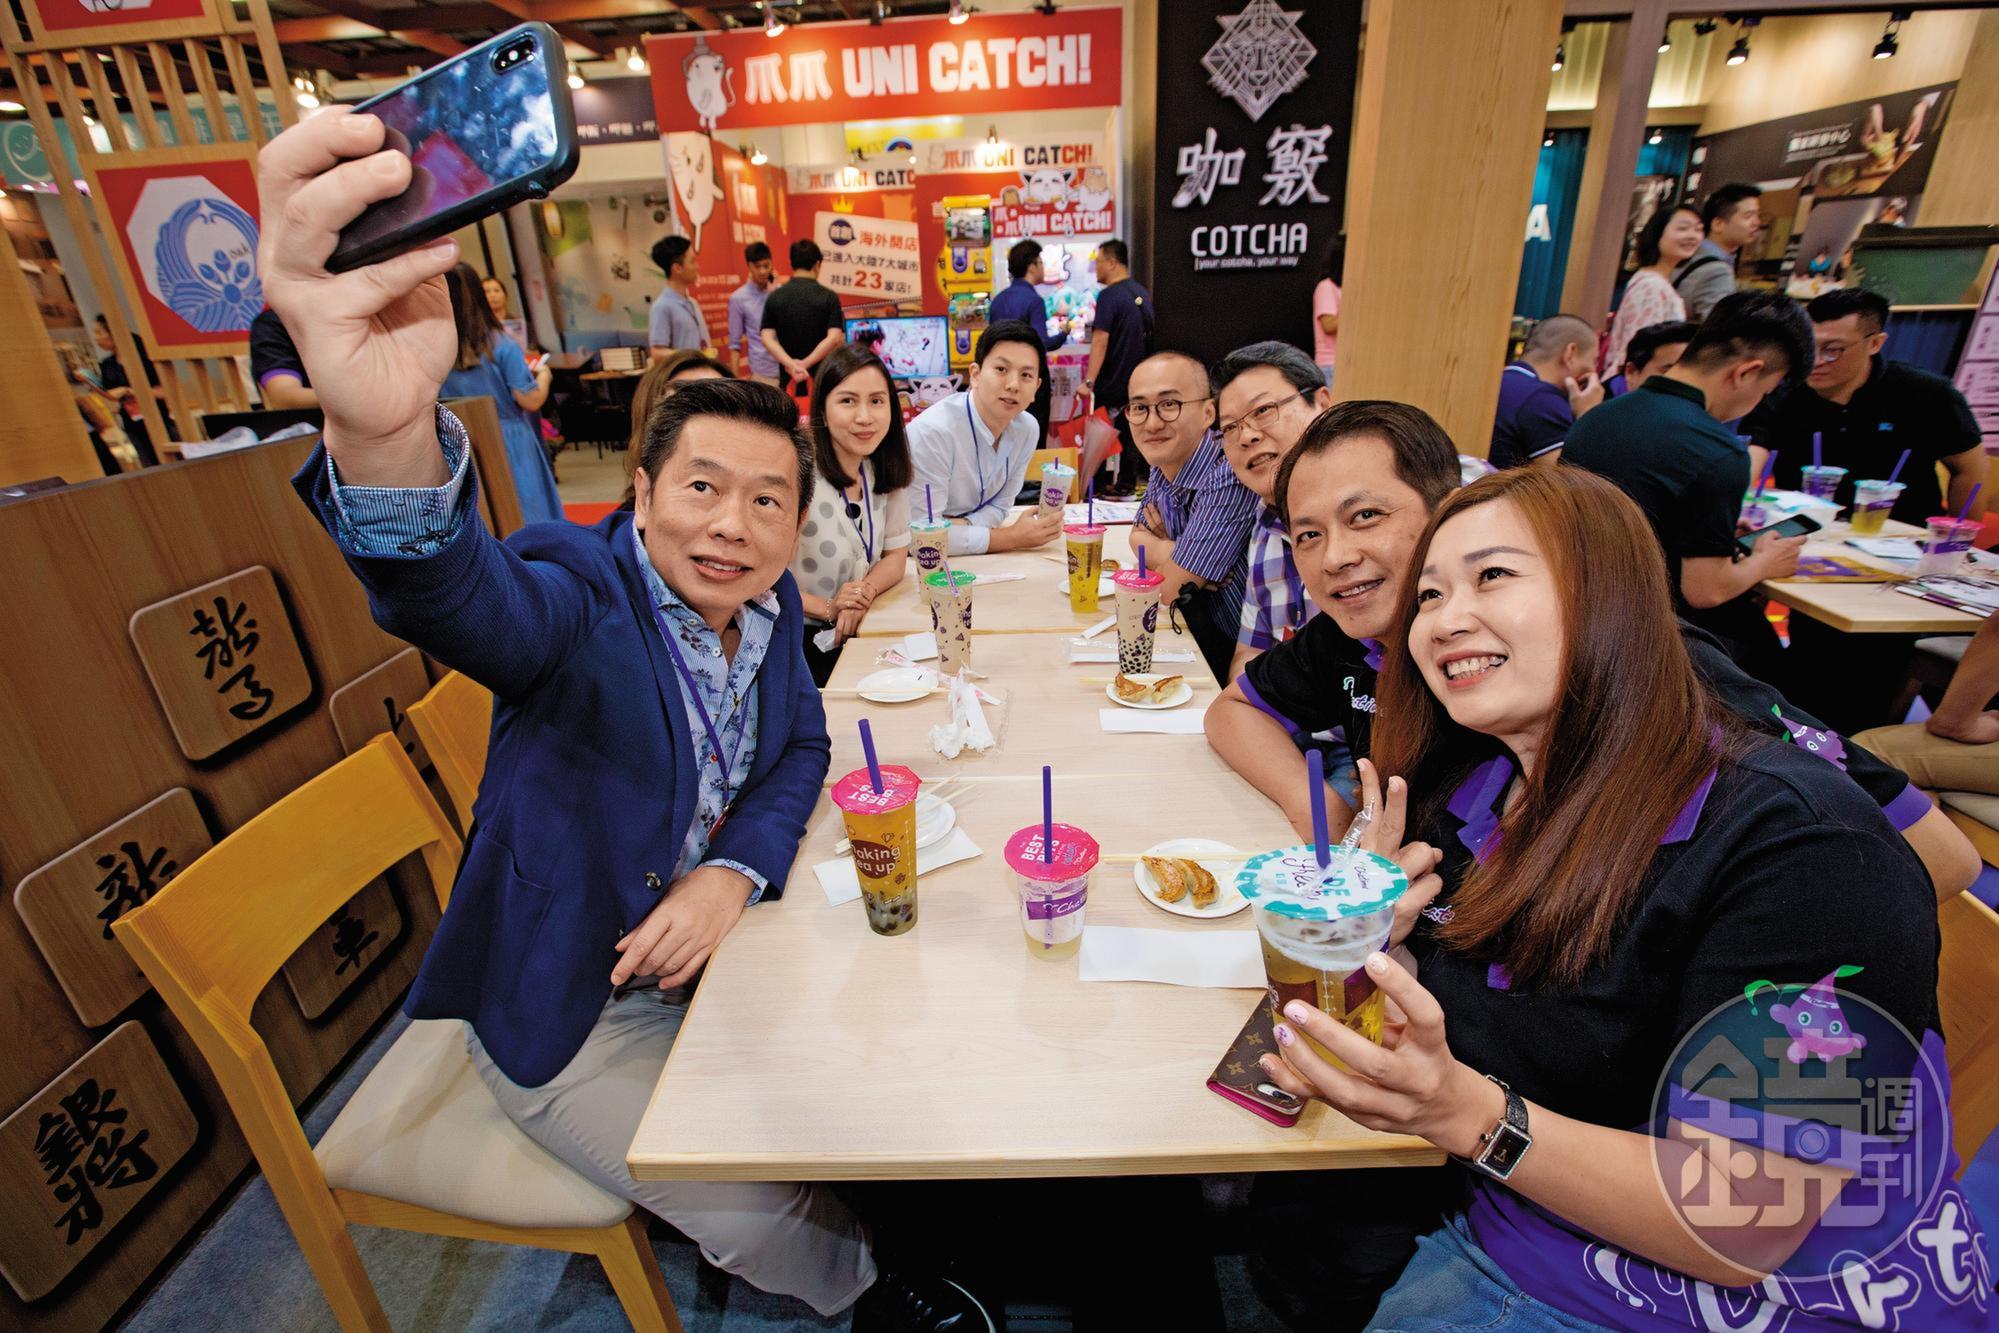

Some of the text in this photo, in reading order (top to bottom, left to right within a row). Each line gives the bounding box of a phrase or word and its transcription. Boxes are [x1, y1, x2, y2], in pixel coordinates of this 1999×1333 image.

[842, 45, 919, 97] UNI
[928, 33, 1092, 93] CATCH!
[1024, 144, 1093, 165] CATCH!
[1018, 212, 1048, 234] UNI
[1050, 210, 1112, 232] CATCH!
[1191, 222, 1308, 257] COTCHA
[848, 790, 890, 806] BEST
[851, 846, 901, 860] aking
[1021, 834, 1045, 861] BEST
[876, 861, 896, 874] up
